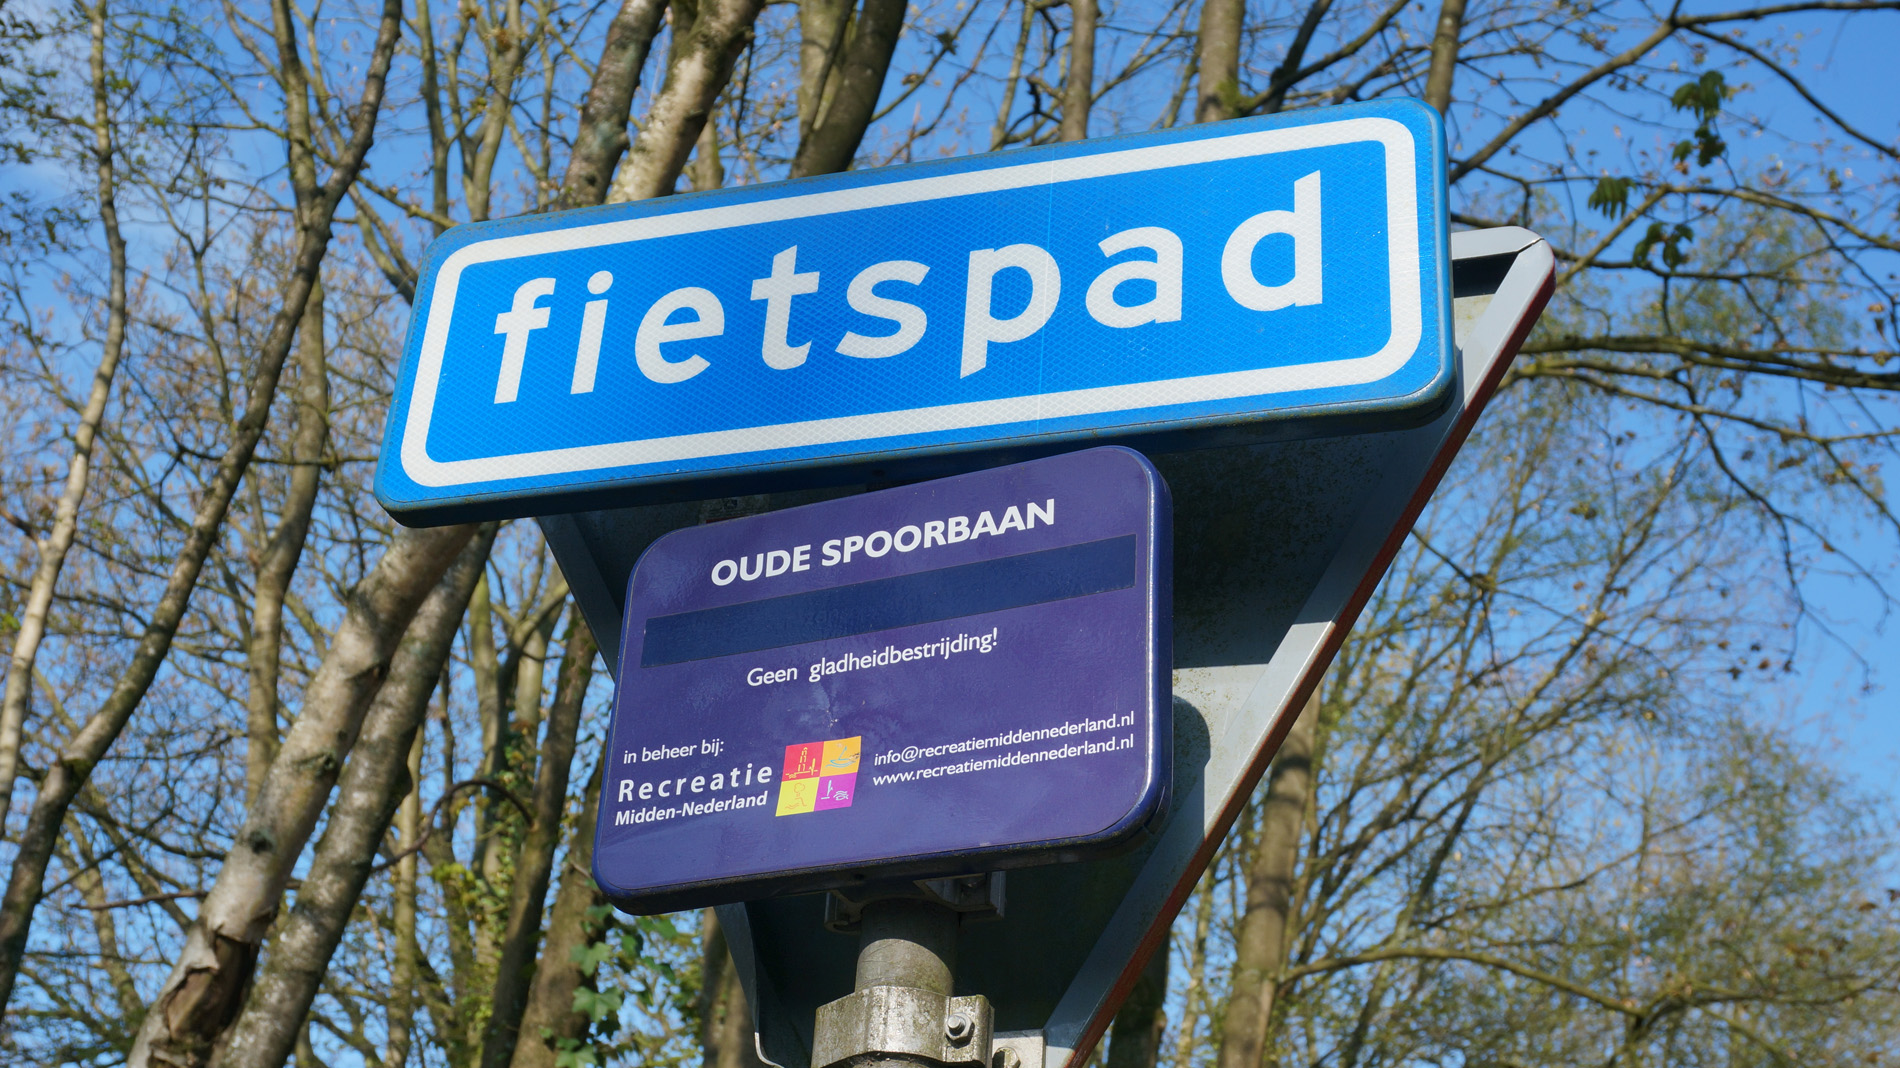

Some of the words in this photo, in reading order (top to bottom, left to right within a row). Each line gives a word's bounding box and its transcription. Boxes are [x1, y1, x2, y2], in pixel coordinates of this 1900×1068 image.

[493, 170, 1323, 404] fietspad
[711, 544, 811, 586] OUDE
[821, 498, 1055, 567] SPOORBAAN
[746, 664, 798, 688] Geen
[808, 626, 998, 683] gladheidbestrijding!
[623, 750, 637, 764] in
[641, 743, 697, 761] beheer
[701, 738, 724, 757] bij:
[872, 733, 1134, 786] www.recreatiemiddennederland.nl
[873, 710, 1135, 767] info@recreatiemiddennederland.nl
[614, 790, 768, 826] Midden-Nederland
[618, 763, 773, 803] Recreatie
